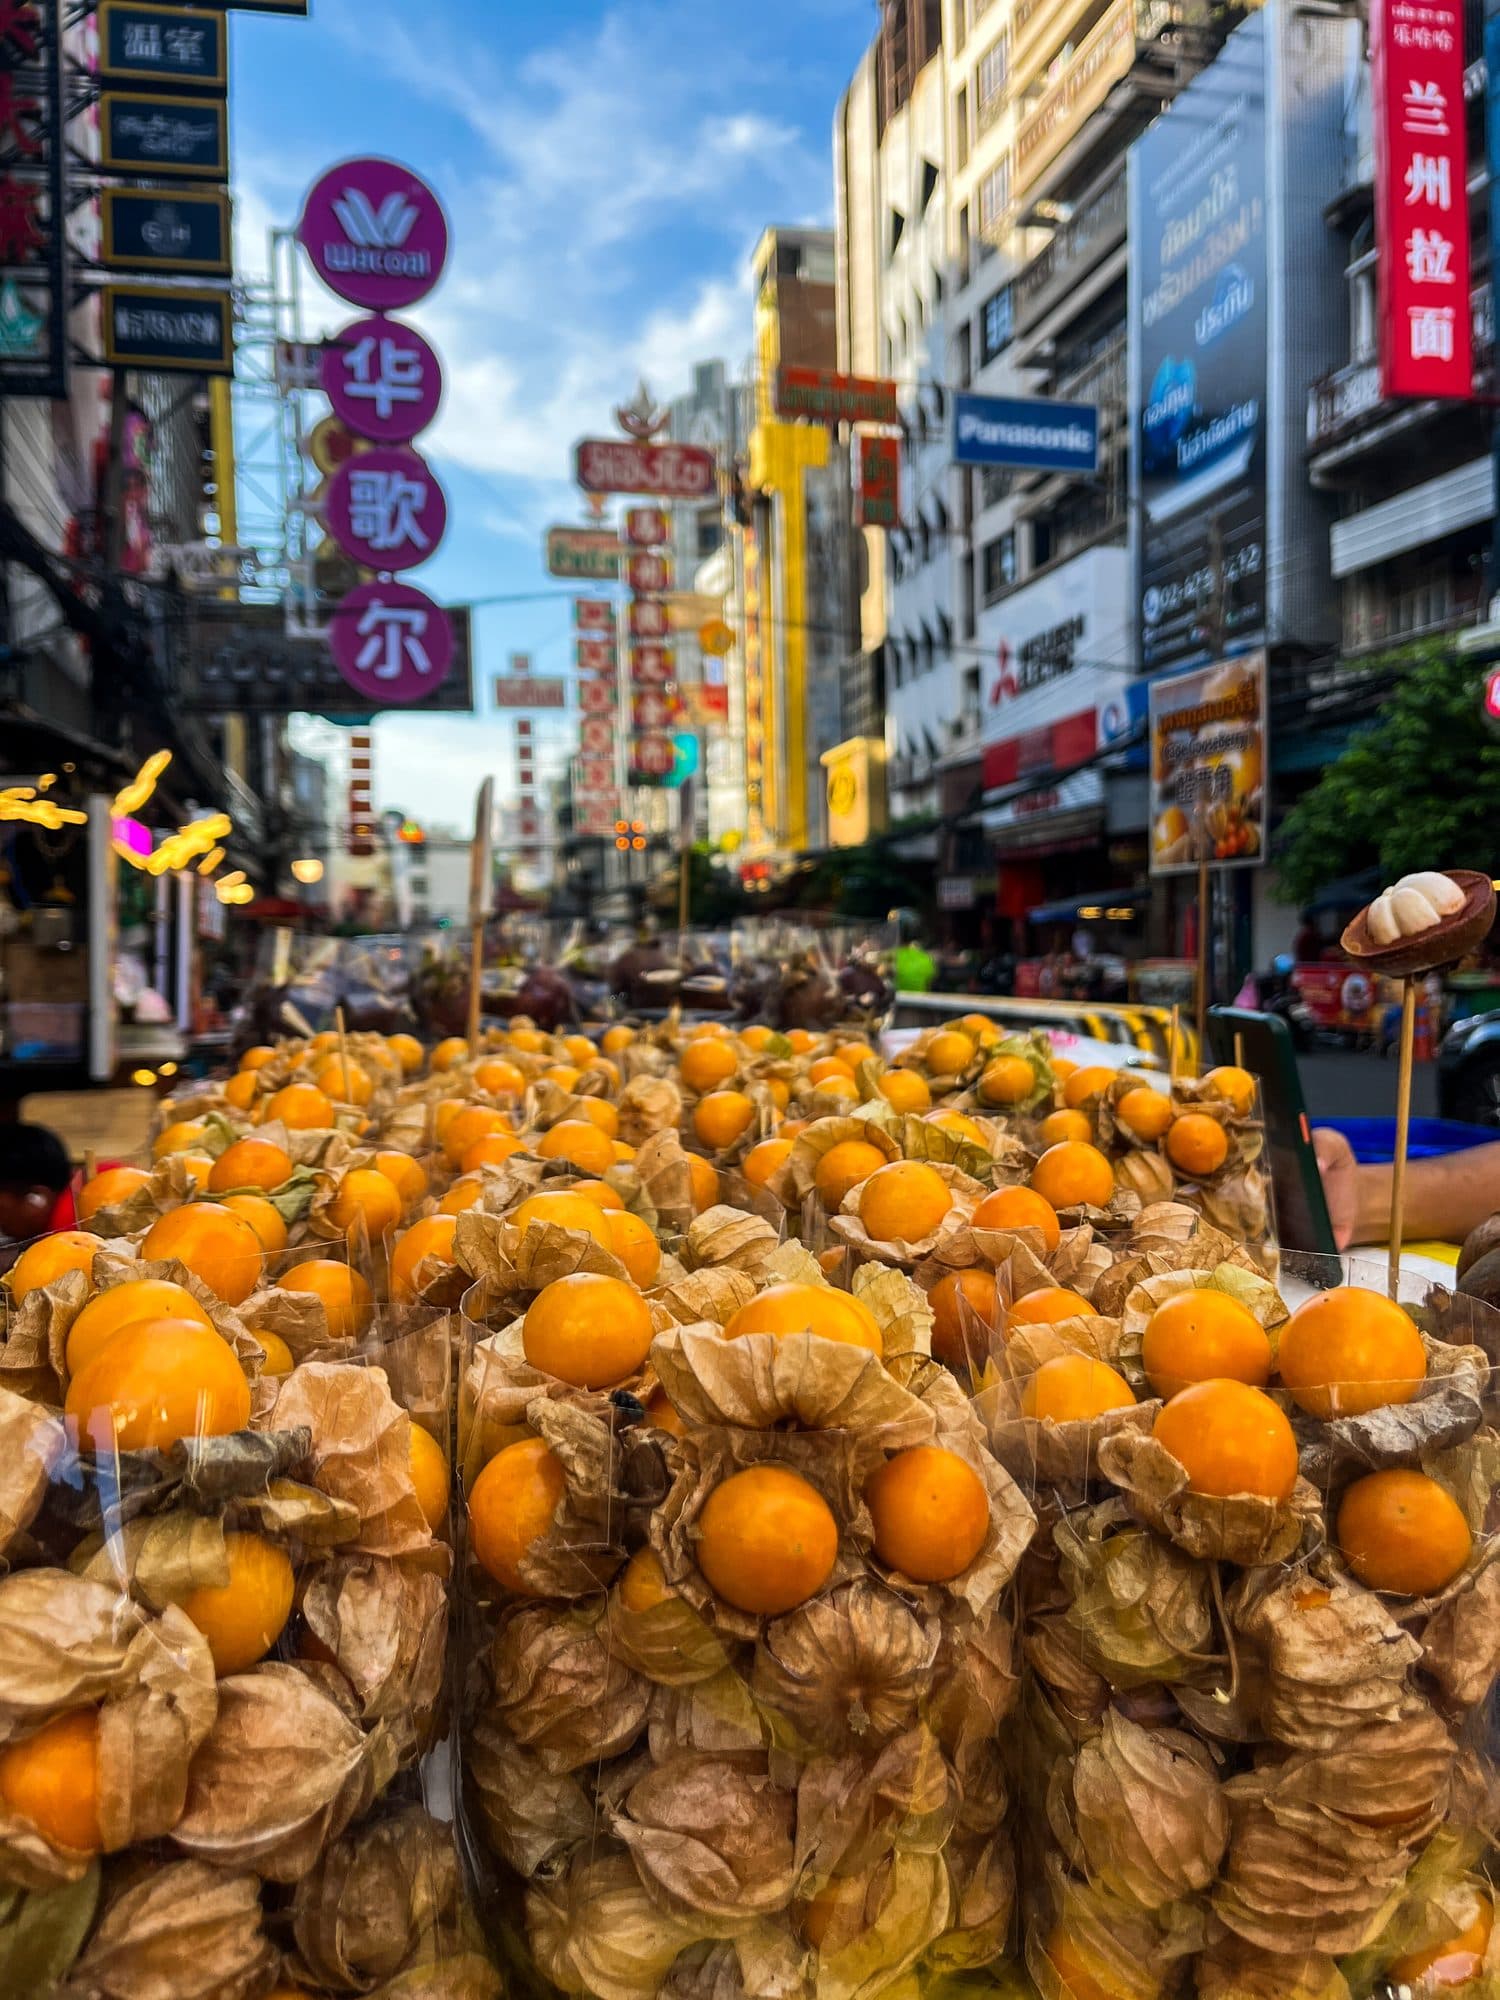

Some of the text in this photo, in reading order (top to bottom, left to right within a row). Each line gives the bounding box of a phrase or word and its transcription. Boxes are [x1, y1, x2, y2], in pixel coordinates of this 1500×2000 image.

[324, 243, 430, 279] Wacoal
[1402, 79, 1457, 361] 兰州拉面
[343, 336, 431, 680] 华歌尔
[958, 414, 1093, 454] Panasonic
